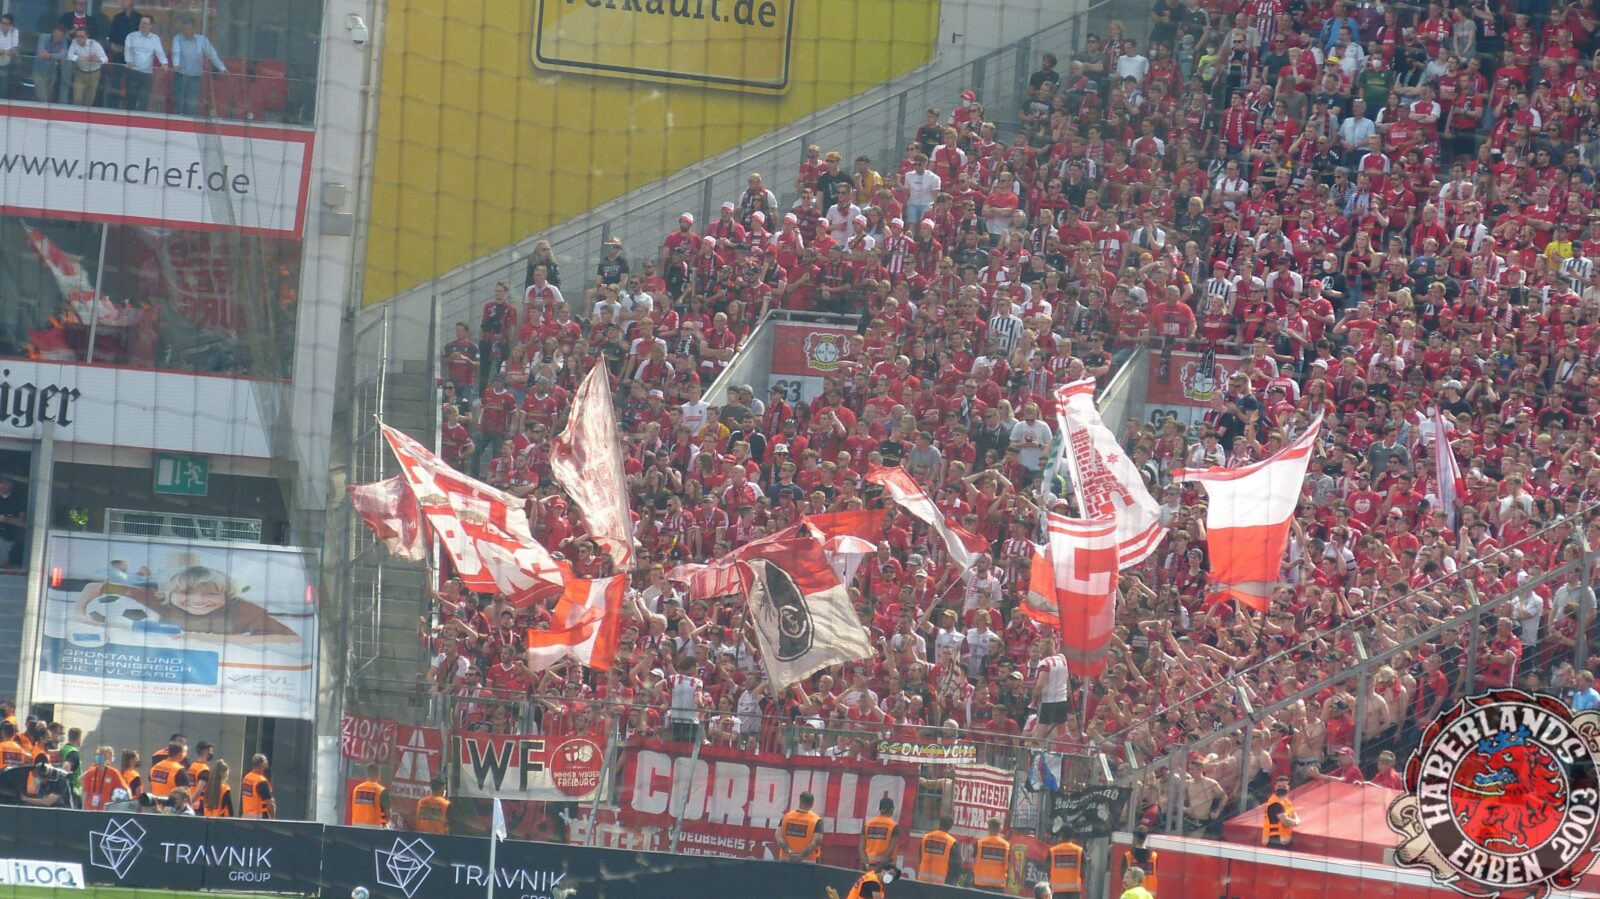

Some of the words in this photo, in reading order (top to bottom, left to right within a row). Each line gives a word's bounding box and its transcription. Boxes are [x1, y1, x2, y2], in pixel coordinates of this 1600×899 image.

[63, 648, 140, 662] SPONTAN
[146, 656, 182, 665] UND
[62, 664, 88, 672] DIE
[252, 675, 295, 686] EVL
[557, 777, 596, 787] FREIBURG
[631, 749, 906, 834] CORRILLO
[160, 842, 273, 868] TRAVNIK
[228, 870, 271, 882] GROUP
[450, 863, 567, 892] TRAVNIK
